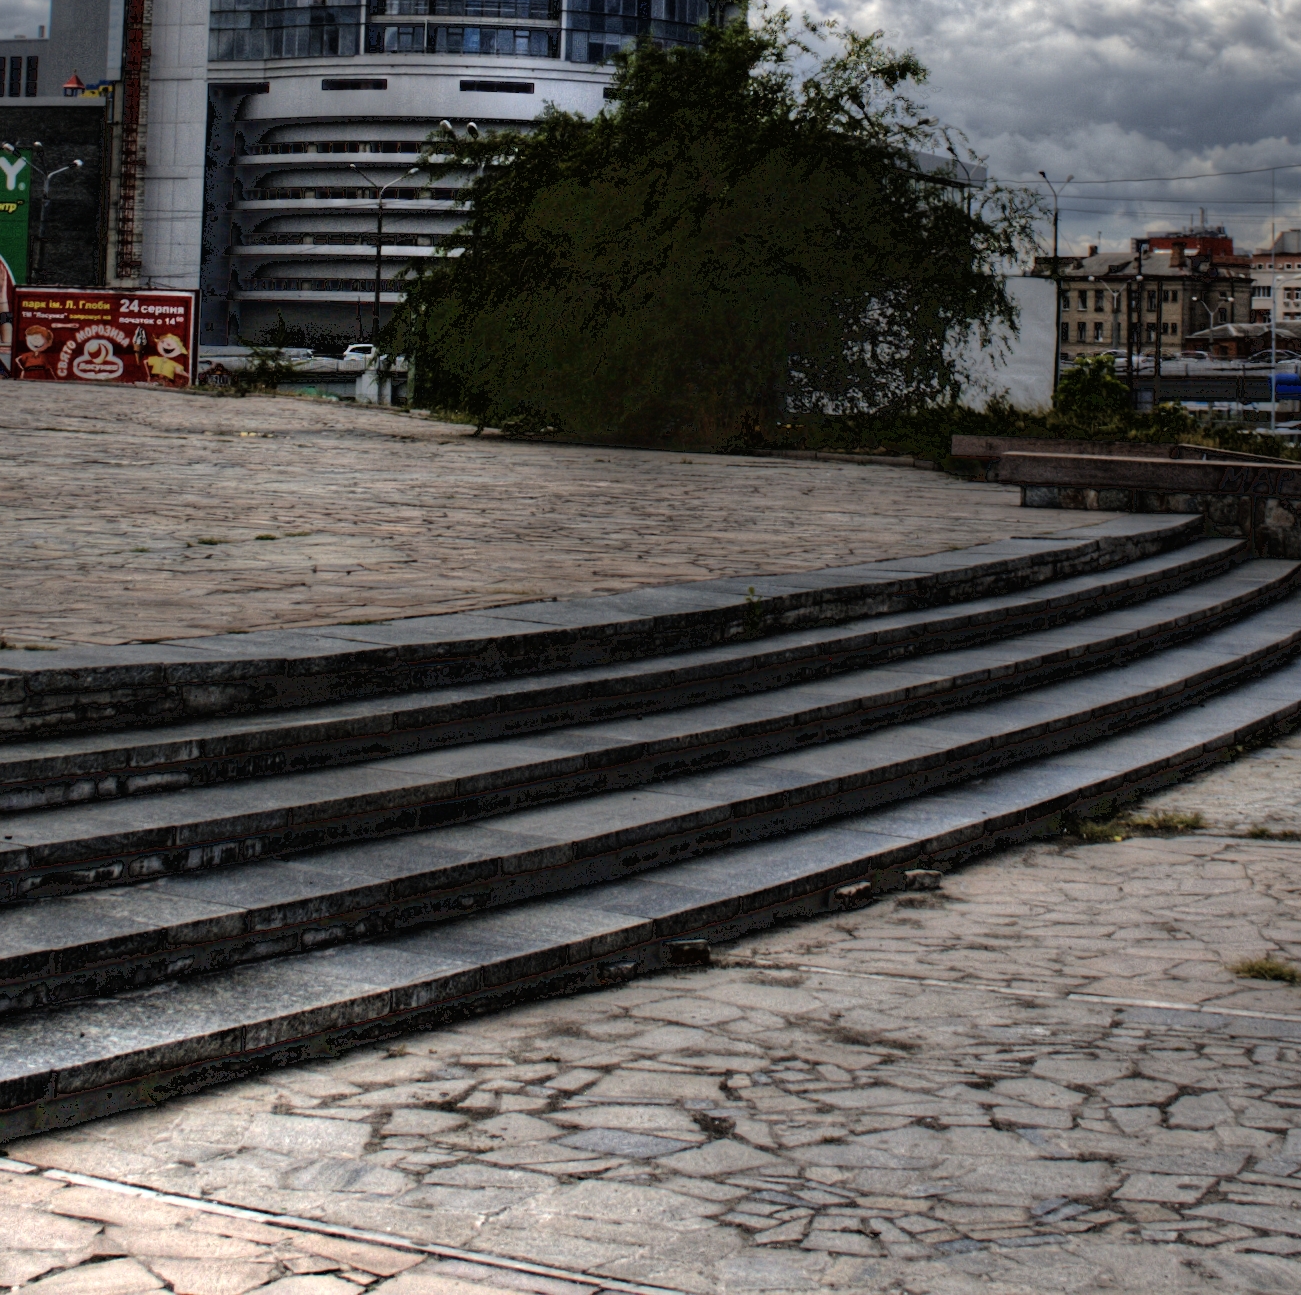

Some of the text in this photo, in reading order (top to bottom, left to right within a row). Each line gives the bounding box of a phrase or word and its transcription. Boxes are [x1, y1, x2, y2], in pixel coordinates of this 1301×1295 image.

[22, 300, 47, 310] парк
[78, 300, 111, 310] Глоби
[119, 298, 185, 316] 24 серпня
[118, 317, 155, 325] початок
[56, 323, 130, 377] СВЯТО МОРОЗИВА
